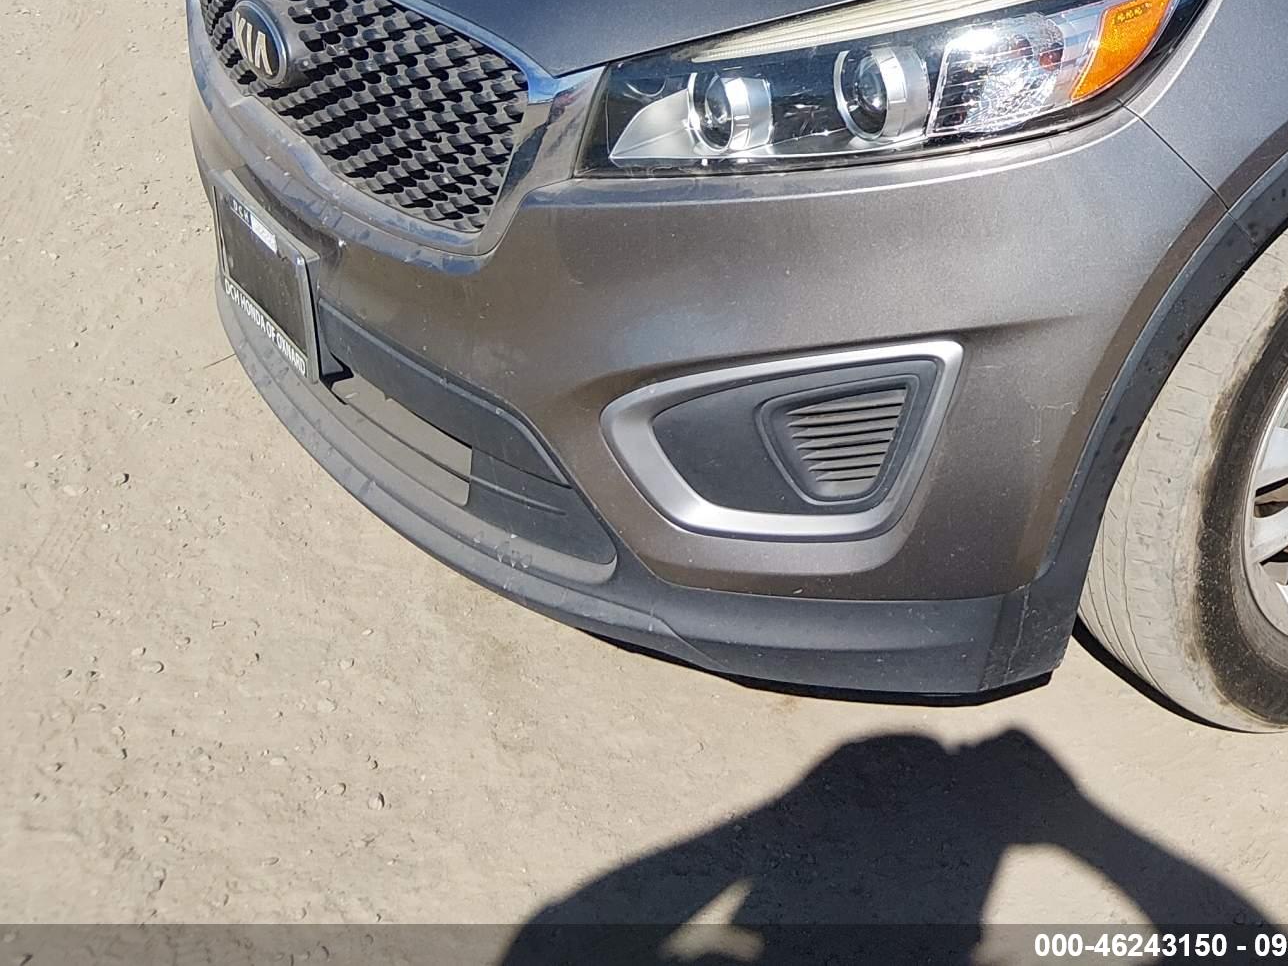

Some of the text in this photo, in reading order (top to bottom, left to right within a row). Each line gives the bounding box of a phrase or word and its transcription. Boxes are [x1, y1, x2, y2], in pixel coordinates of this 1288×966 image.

[235, 10, 273, 76] KIA
[224, 278, 306, 376] DCH HONDA OF OXNARD
